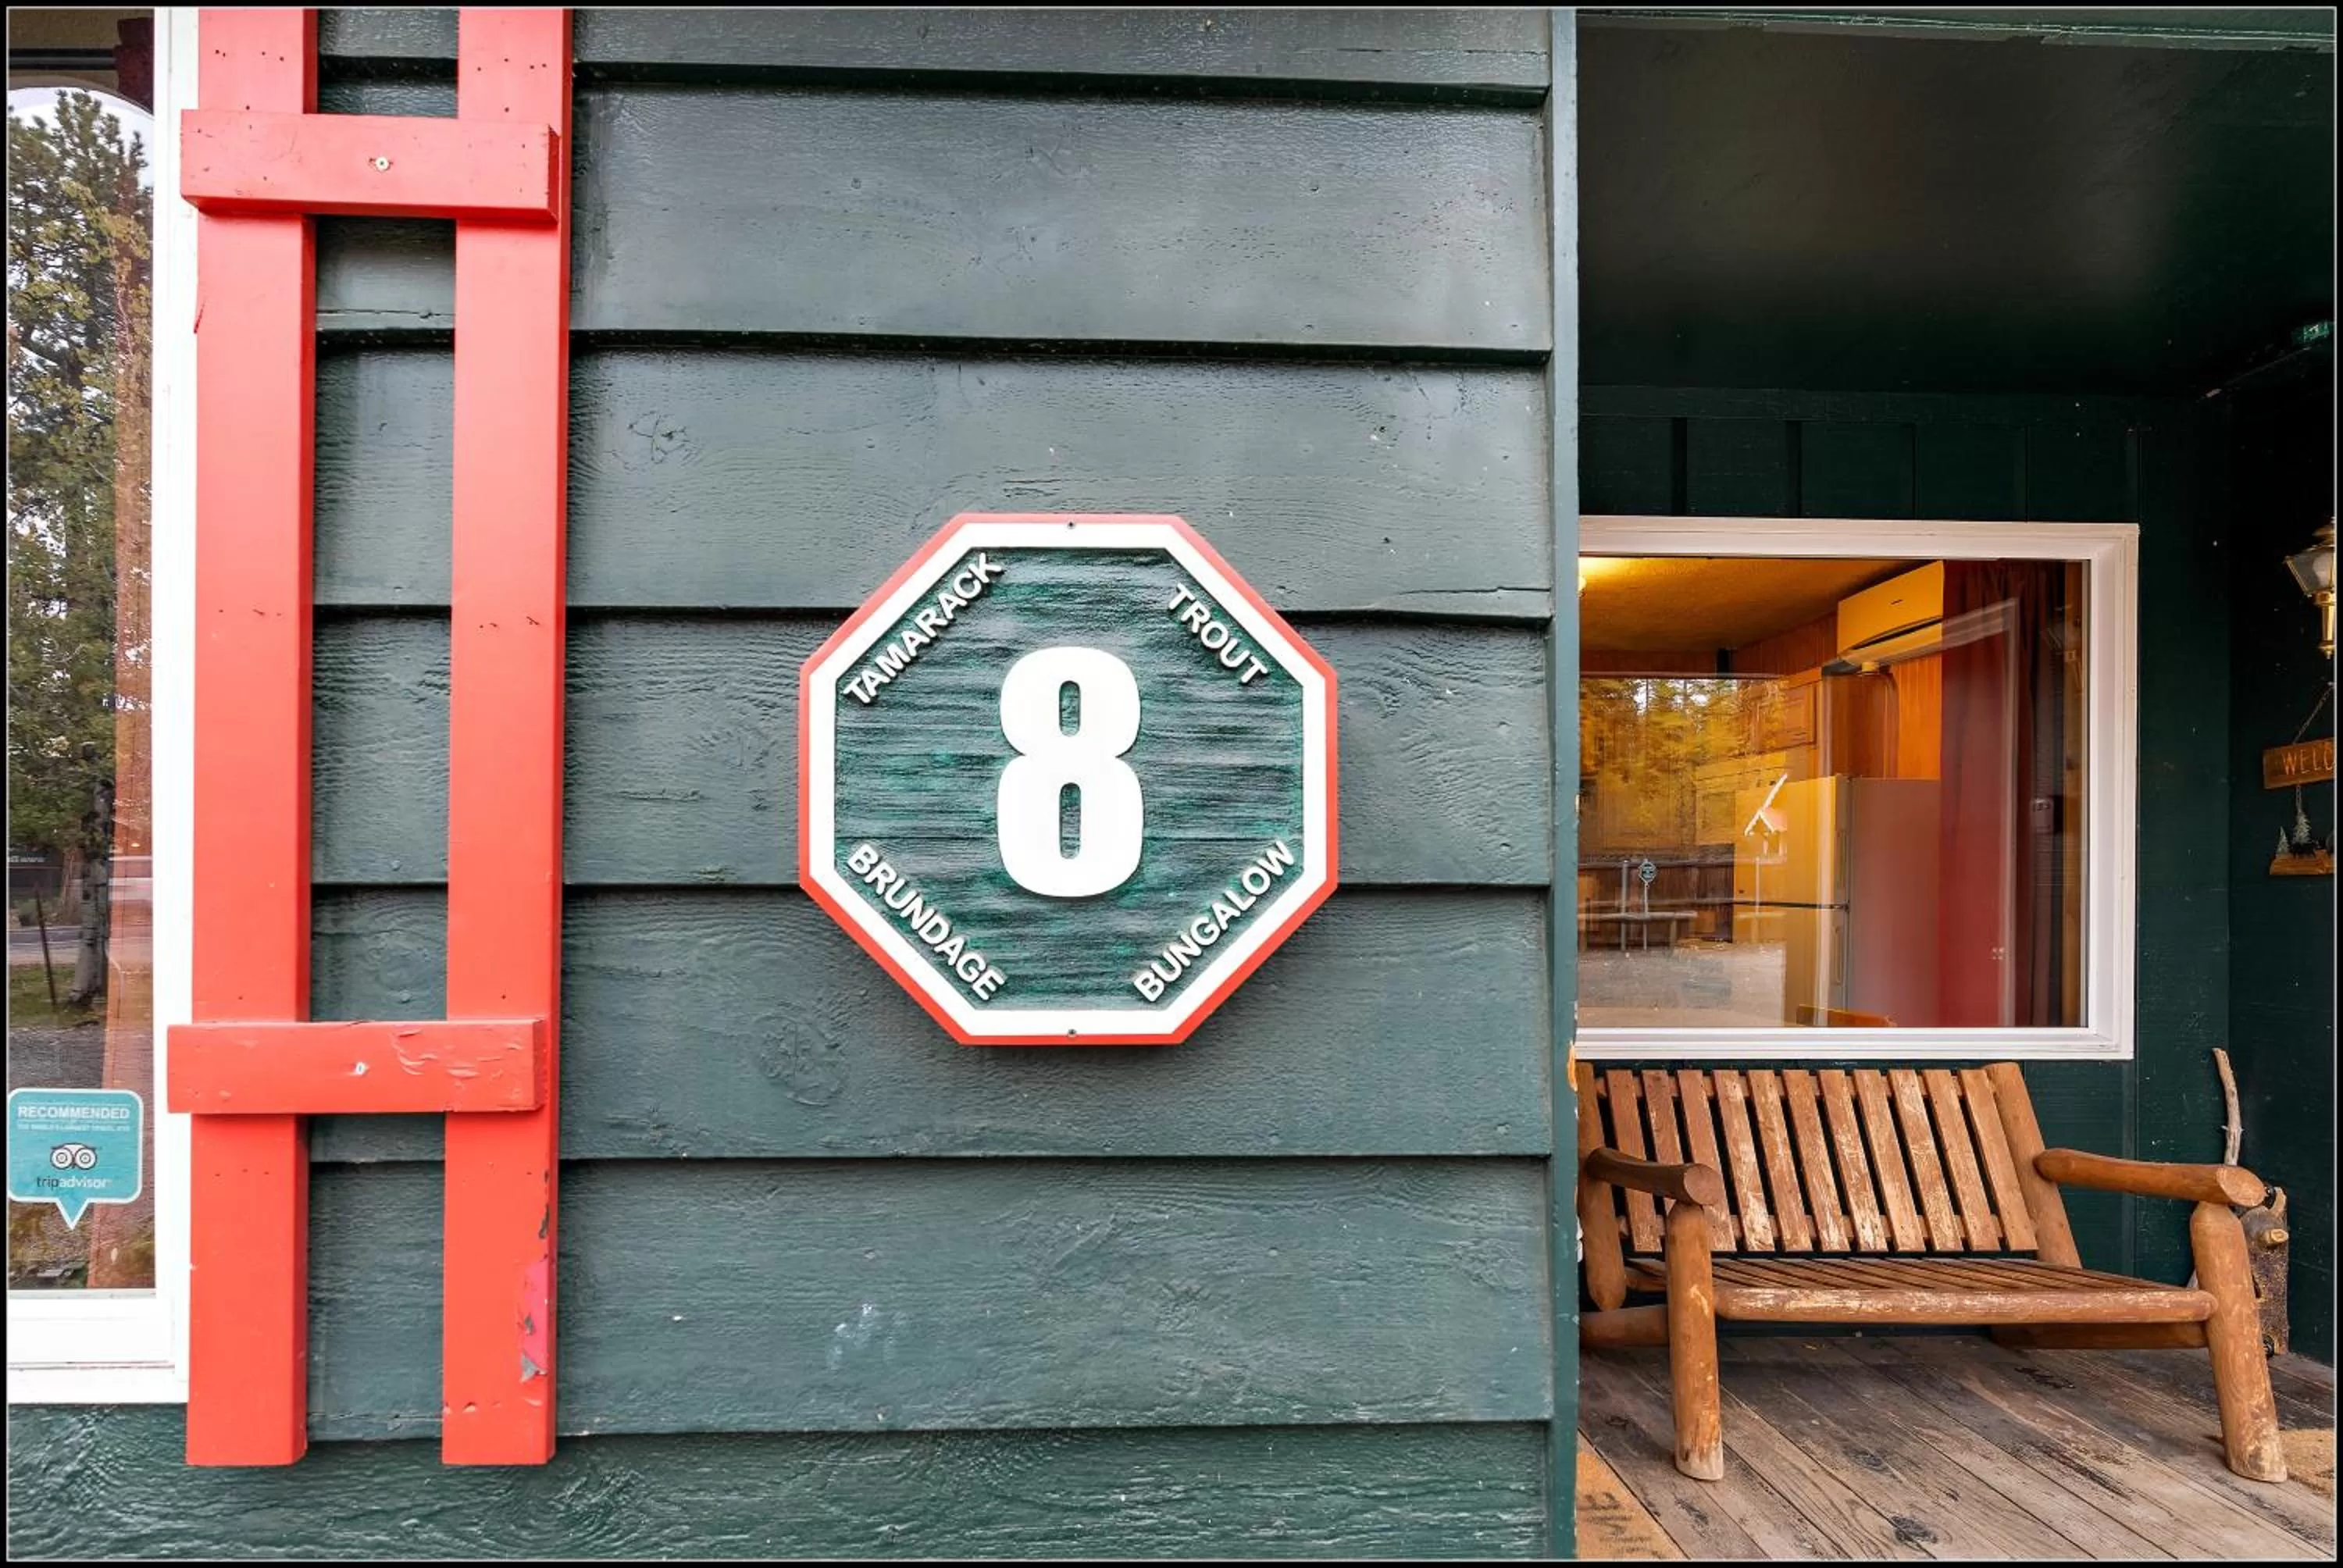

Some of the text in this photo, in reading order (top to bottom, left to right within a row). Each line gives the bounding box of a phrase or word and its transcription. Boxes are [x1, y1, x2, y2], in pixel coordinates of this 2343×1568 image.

[843, 552, 1003, 704] TAMARACK
[1169, 583, 1268, 683] TROUT
[997, 647, 1143, 897] 8
[847, 844, 1005, 1000] BRUNDAGE
[1133, 841, 1296, 1002] BUNGALOW
[17, 1106, 130, 1119] RECOMMENDED
[36, 1175, 108, 1191] tripadvisor
